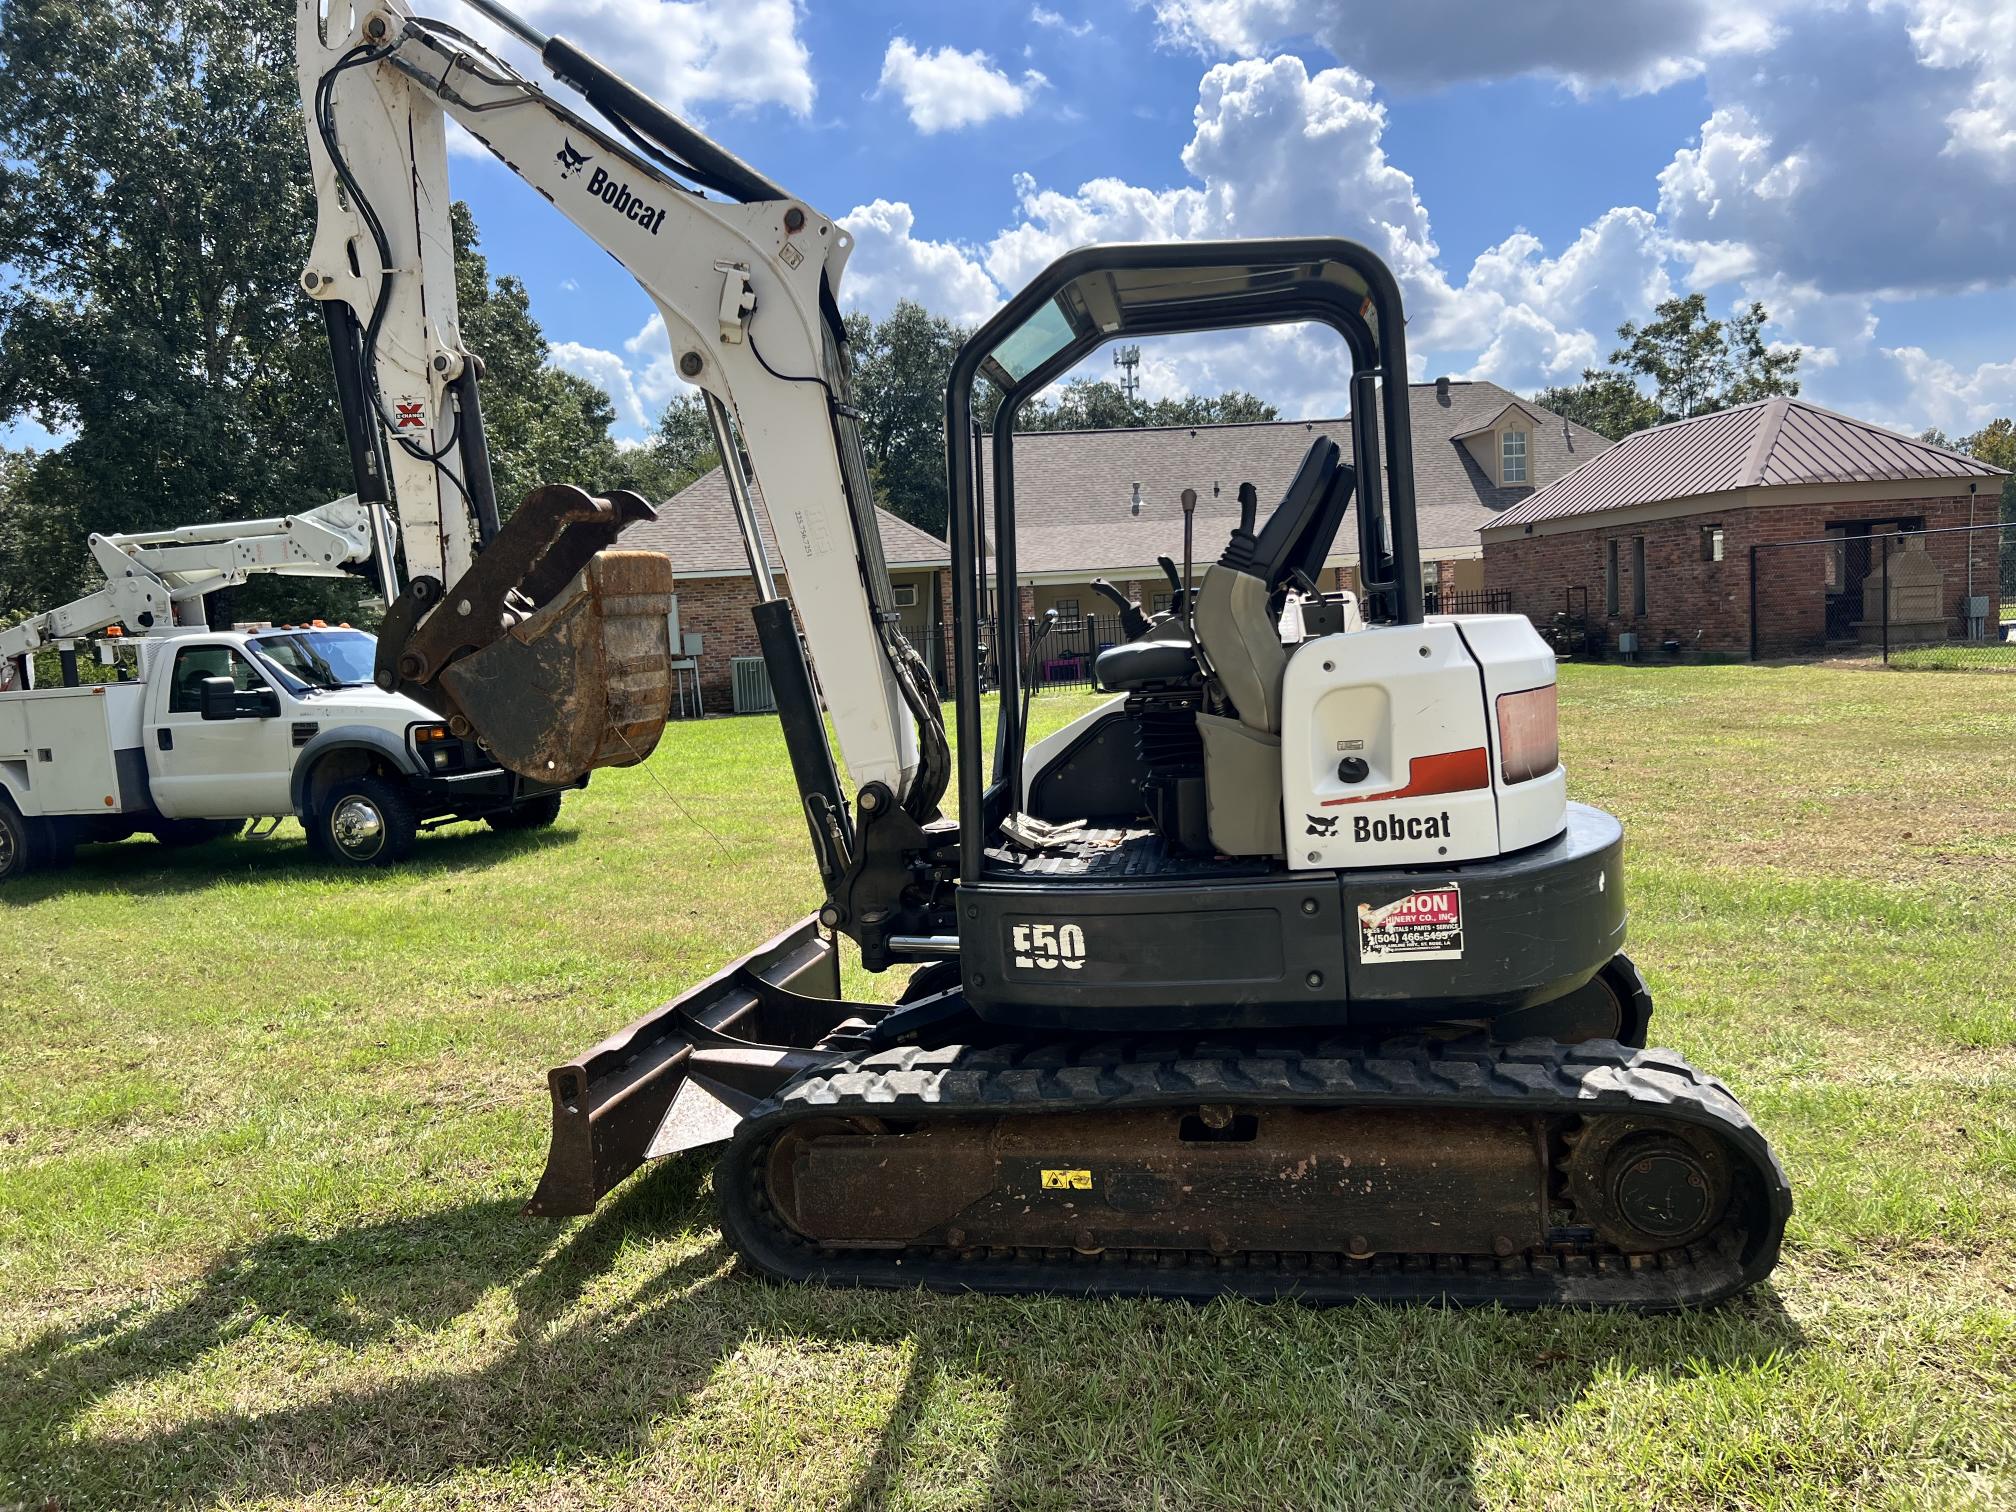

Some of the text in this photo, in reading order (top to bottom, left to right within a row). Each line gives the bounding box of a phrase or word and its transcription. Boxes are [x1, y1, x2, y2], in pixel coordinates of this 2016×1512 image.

[587, 166, 666, 236] Bobcat
[1353, 811, 1451, 843] Bobcat
[1383, 914, 1417, 923] HINERY
[1012, 923, 1086, 970] E50
[1374, 933, 1399, 945] (504)
